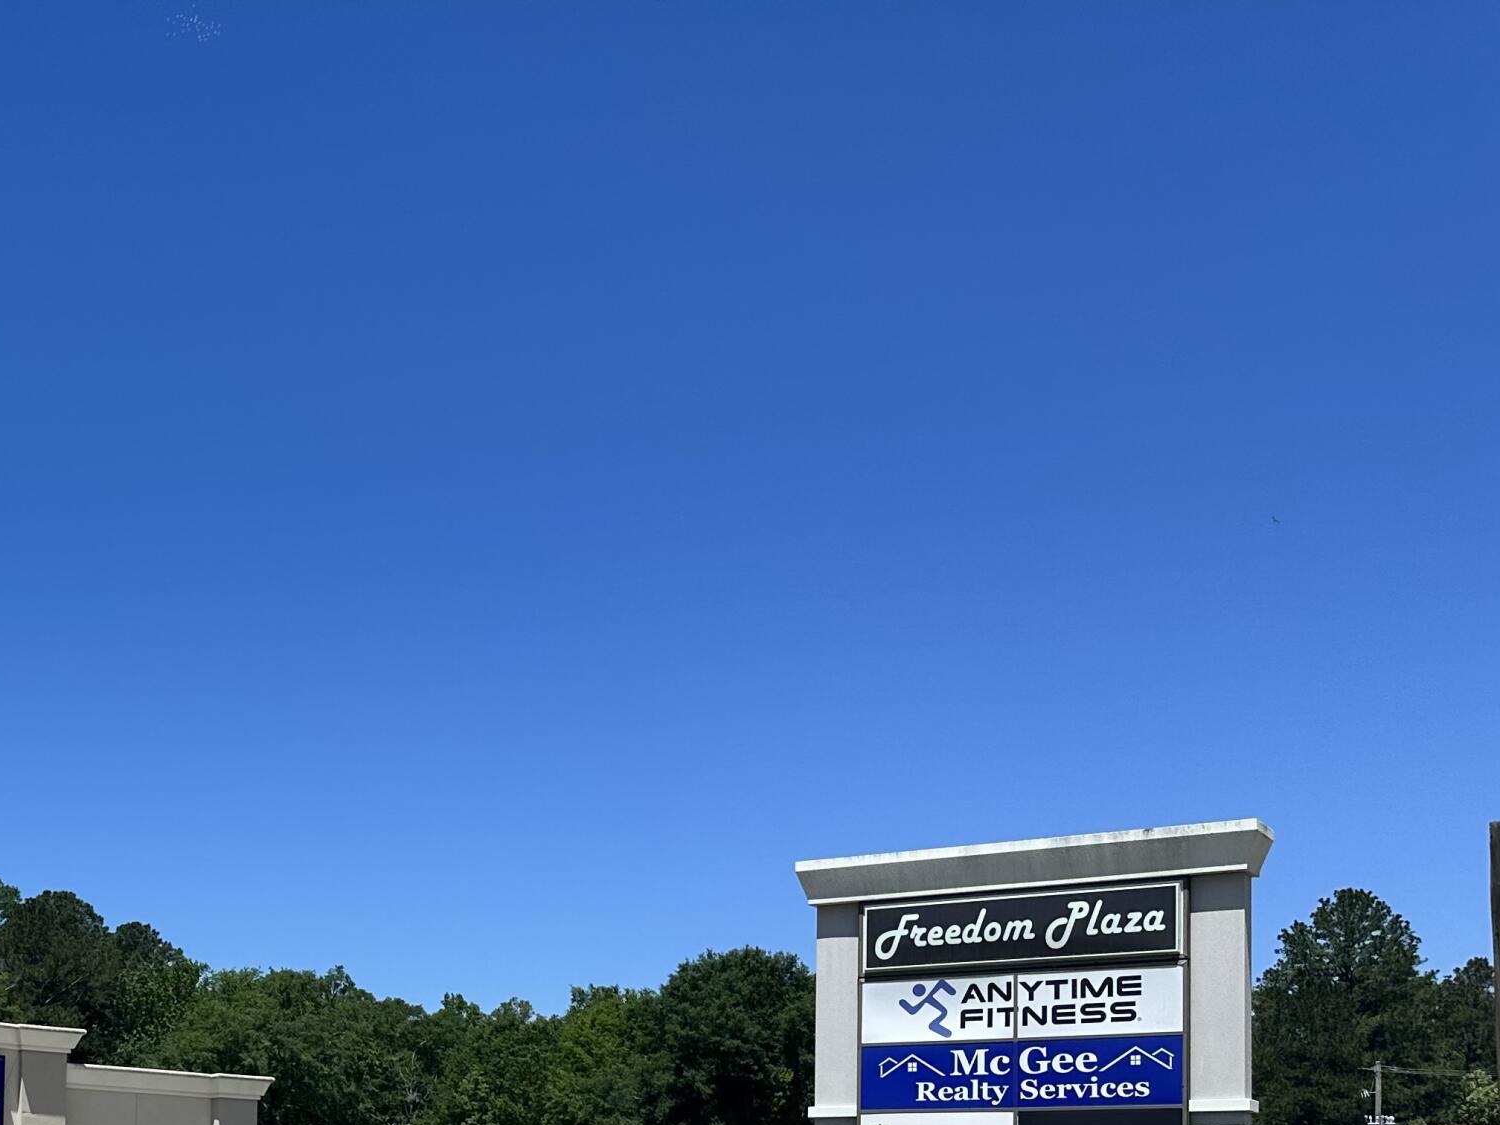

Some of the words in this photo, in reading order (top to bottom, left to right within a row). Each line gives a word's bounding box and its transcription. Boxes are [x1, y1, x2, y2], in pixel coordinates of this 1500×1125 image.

[874, 907, 1036, 961] Freedom
[1045, 899, 1167, 950] Plaza
[960, 974, 1143, 1004] ANYTIME
[959, 1001, 1138, 1030] FITNESS
[915, 1078, 1010, 1106] Realty
[1019, 1076, 1151, 1101] Services
